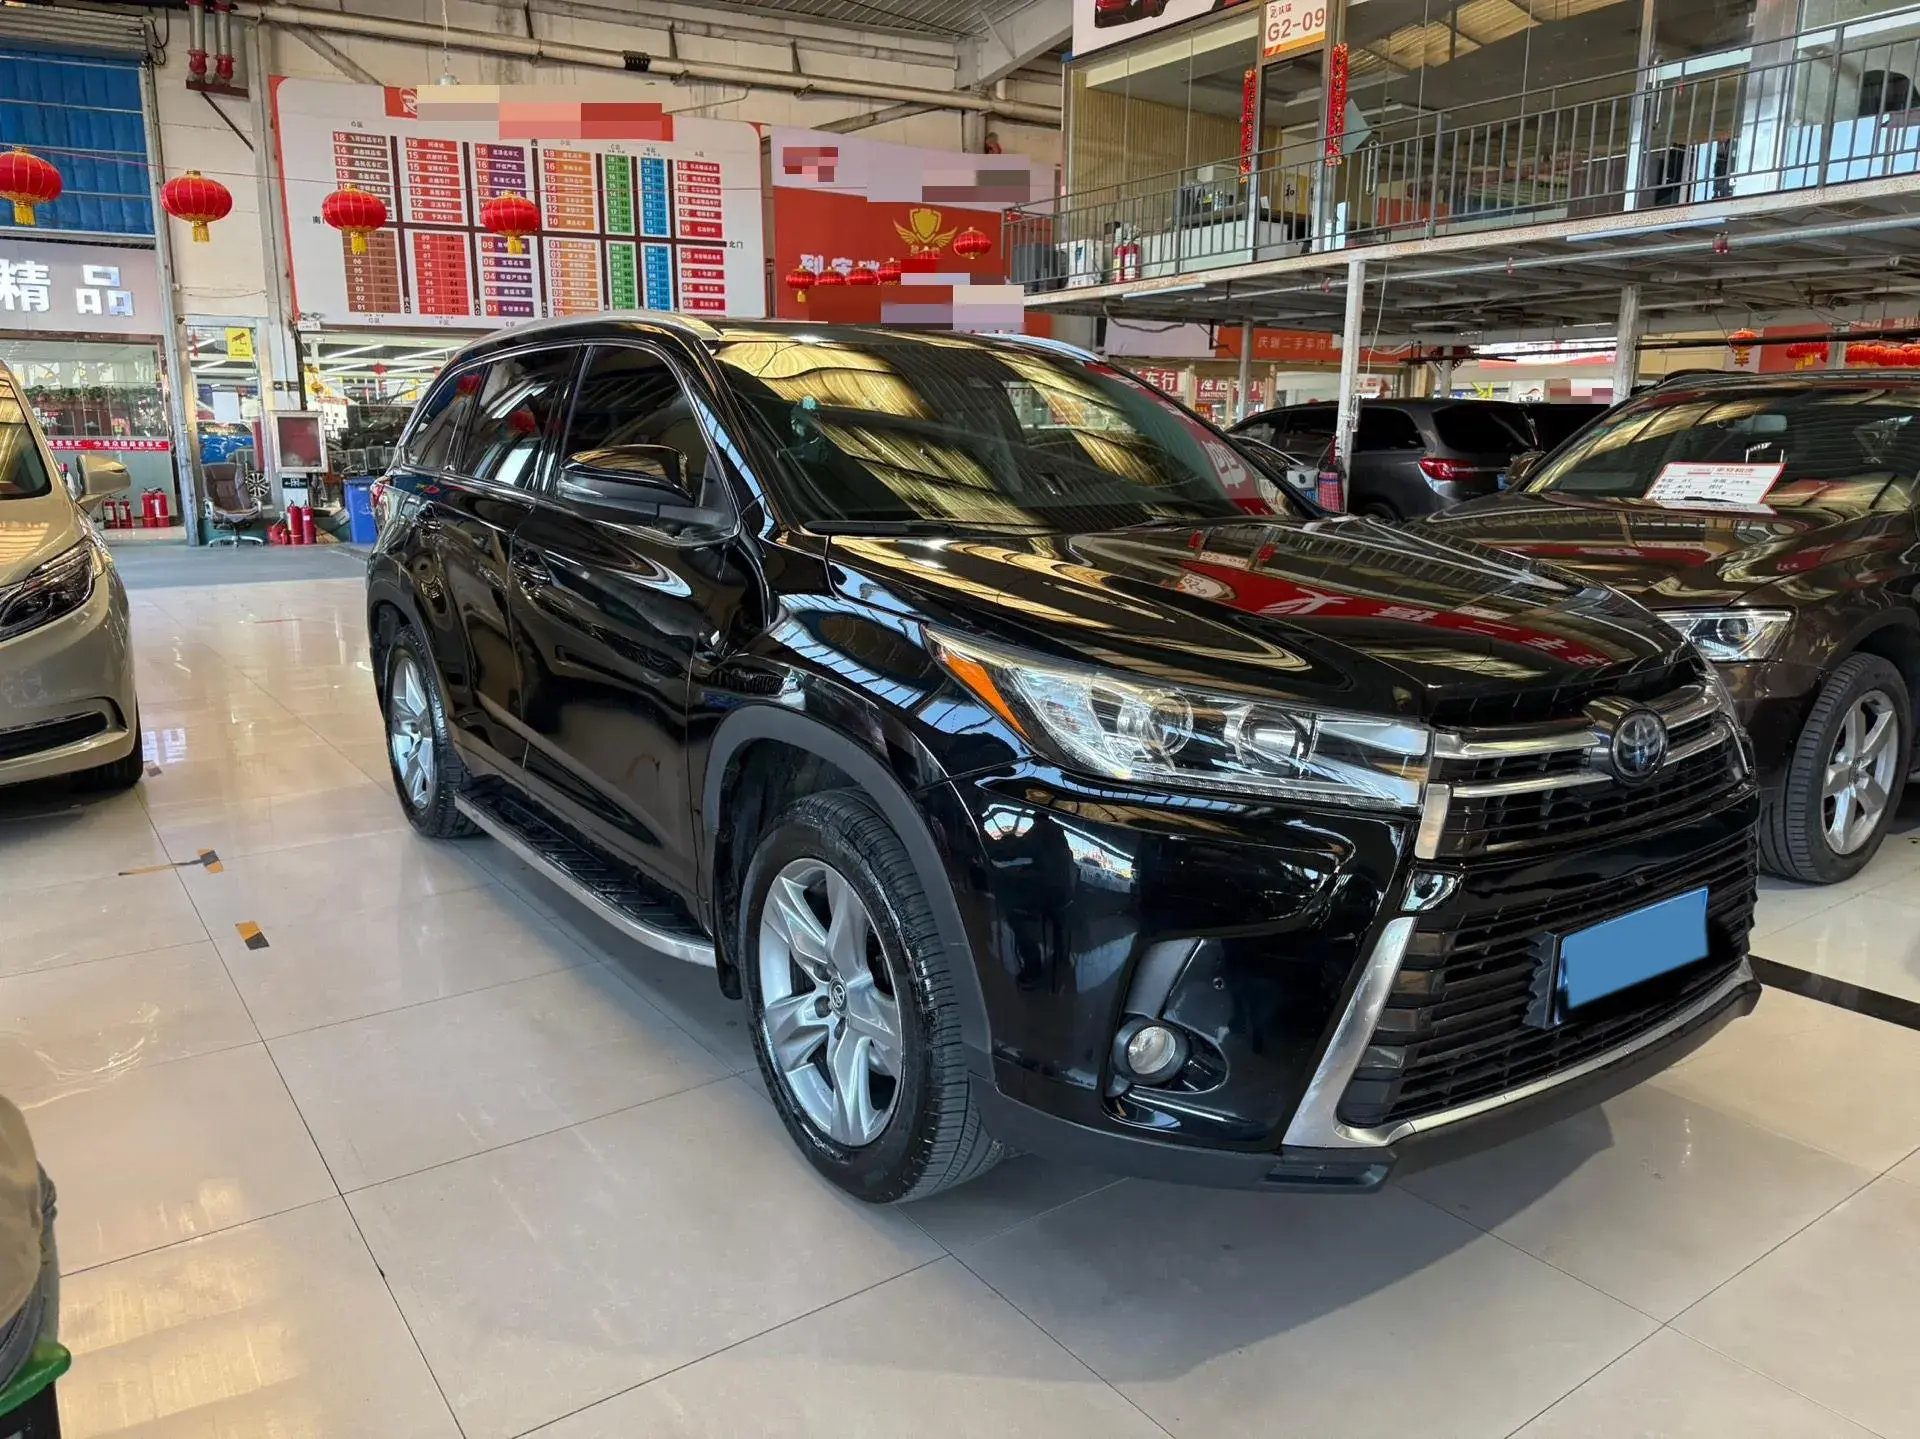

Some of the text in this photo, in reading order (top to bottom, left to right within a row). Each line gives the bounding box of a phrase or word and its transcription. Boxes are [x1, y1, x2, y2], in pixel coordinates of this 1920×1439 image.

[1267, 7, 1325, 42] G2-09
[729, 240, 744, 249] 北门
[0, 258, 134, 317] 精品
[1137, 370, 1175, 391] 车行
